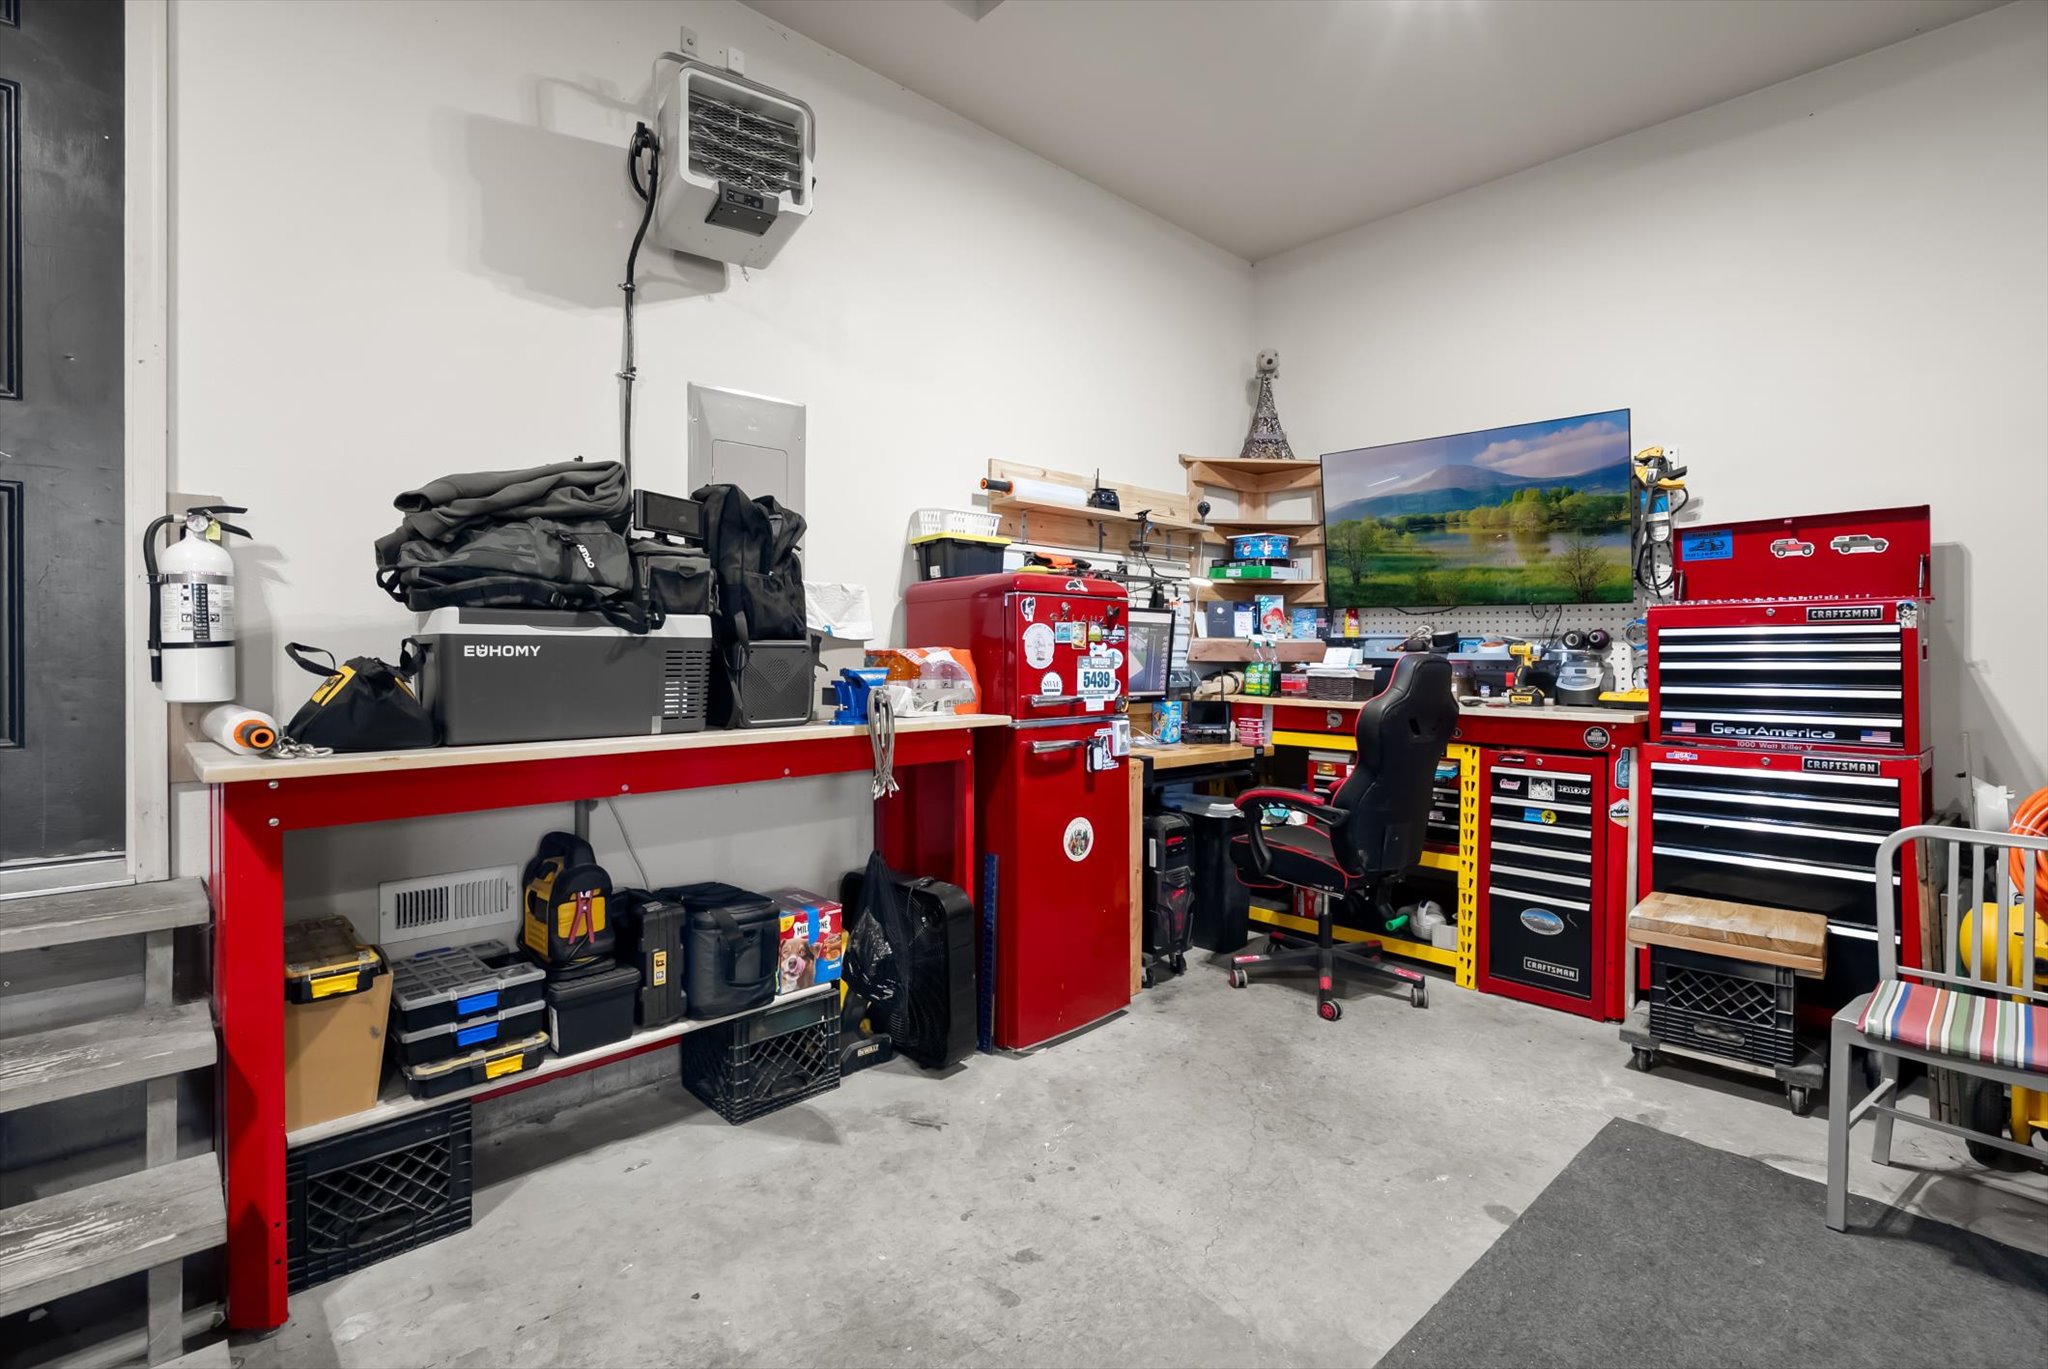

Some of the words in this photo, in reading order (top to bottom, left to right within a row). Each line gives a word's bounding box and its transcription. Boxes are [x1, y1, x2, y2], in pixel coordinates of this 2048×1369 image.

[1811, 608, 1879, 620] CRAFTSMAN
[463, 644, 541, 658] EUHOMY
[1083, 671, 1111, 689] 5439
[1711, 722, 1836, 739] GearAmerica
[1737, 740, 1755, 748] 1000
[1759, 741, 1778, 749] Watt
[1781, 743, 1803, 751] Killer
[1806, 759, 1876, 772] CRAFTSMAN
[1527, 961, 1575, 978] CRAFTSMAN
